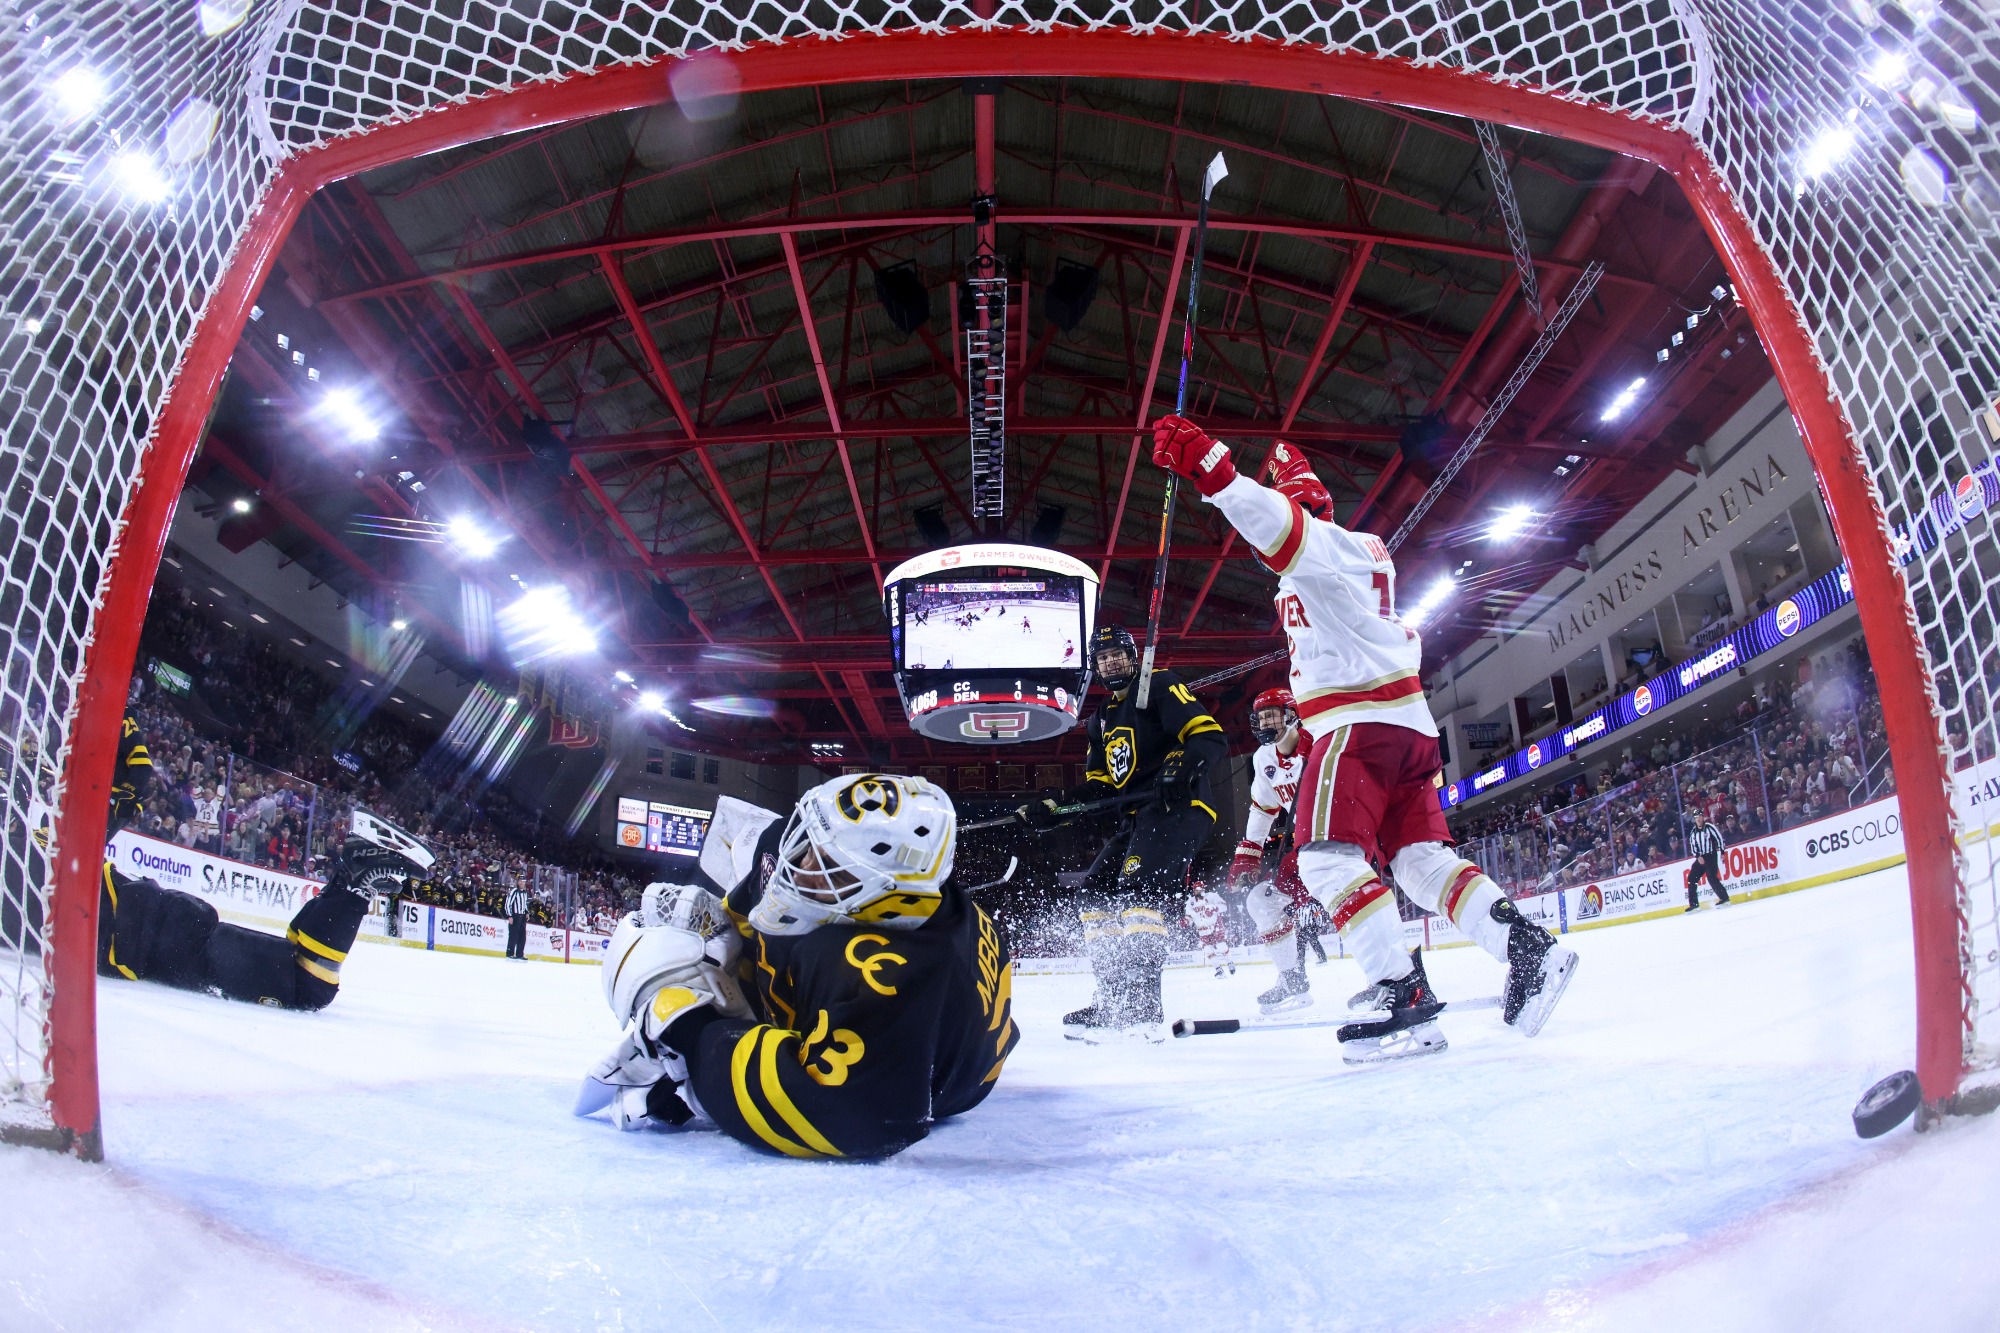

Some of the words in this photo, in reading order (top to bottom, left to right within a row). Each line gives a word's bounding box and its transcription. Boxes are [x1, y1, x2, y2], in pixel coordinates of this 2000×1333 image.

[973, 551, 1015, 559] FARMER
[1019, 551, 1056, 564] OWNED.
[1547, 549, 1663, 653] MAGNESS
[1683, 454, 1788, 558] ARENA
[891, 585, 899, 628] PEPSI
[1274, 593, 1312, 628] VER
[1778, 610, 1798, 627] PEPSI
[1681, 666, 1694, 687] GO
[1692, 643, 1737, 681] PIONEERS
[953, 681, 971, 692] CC
[1015, 680, 1022, 690] 1
[953, 691, 980, 702] DEN
[1014, 690, 1022, 700] 0
[1168, 683, 1197, 705] 10
[1635, 695, 1650, 706] PEPSI
[1467, 729, 1498, 741] SUITE
[1563, 731, 1574, 747] GO
[1572, 715, 1606, 744] PIONEERS
[202, 811, 211, 821] 13
[652, 804, 684, 814] UNIVERSITY
[652, 832, 658, 843] 0
[1852, 812, 1904, 845] COLO
[1819, 829, 1850, 855] CBS
[131, 846, 192, 878] Quantum
[1722, 845, 1779, 882] JOHNS
[159, 872, 182, 885] FIBER
[201, 864, 298, 911] SAFEWAY
[1740, 877, 1760, 888] Better
[1761, 872, 1781, 883] Pizza.
[1604, 886, 1635, 906] EVANS
[1637, 879, 1665, 898] CASE
[441, 918, 483, 938] canvas
[845, 933, 908, 996] CC
[972, 901, 1001, 1017] MBE
